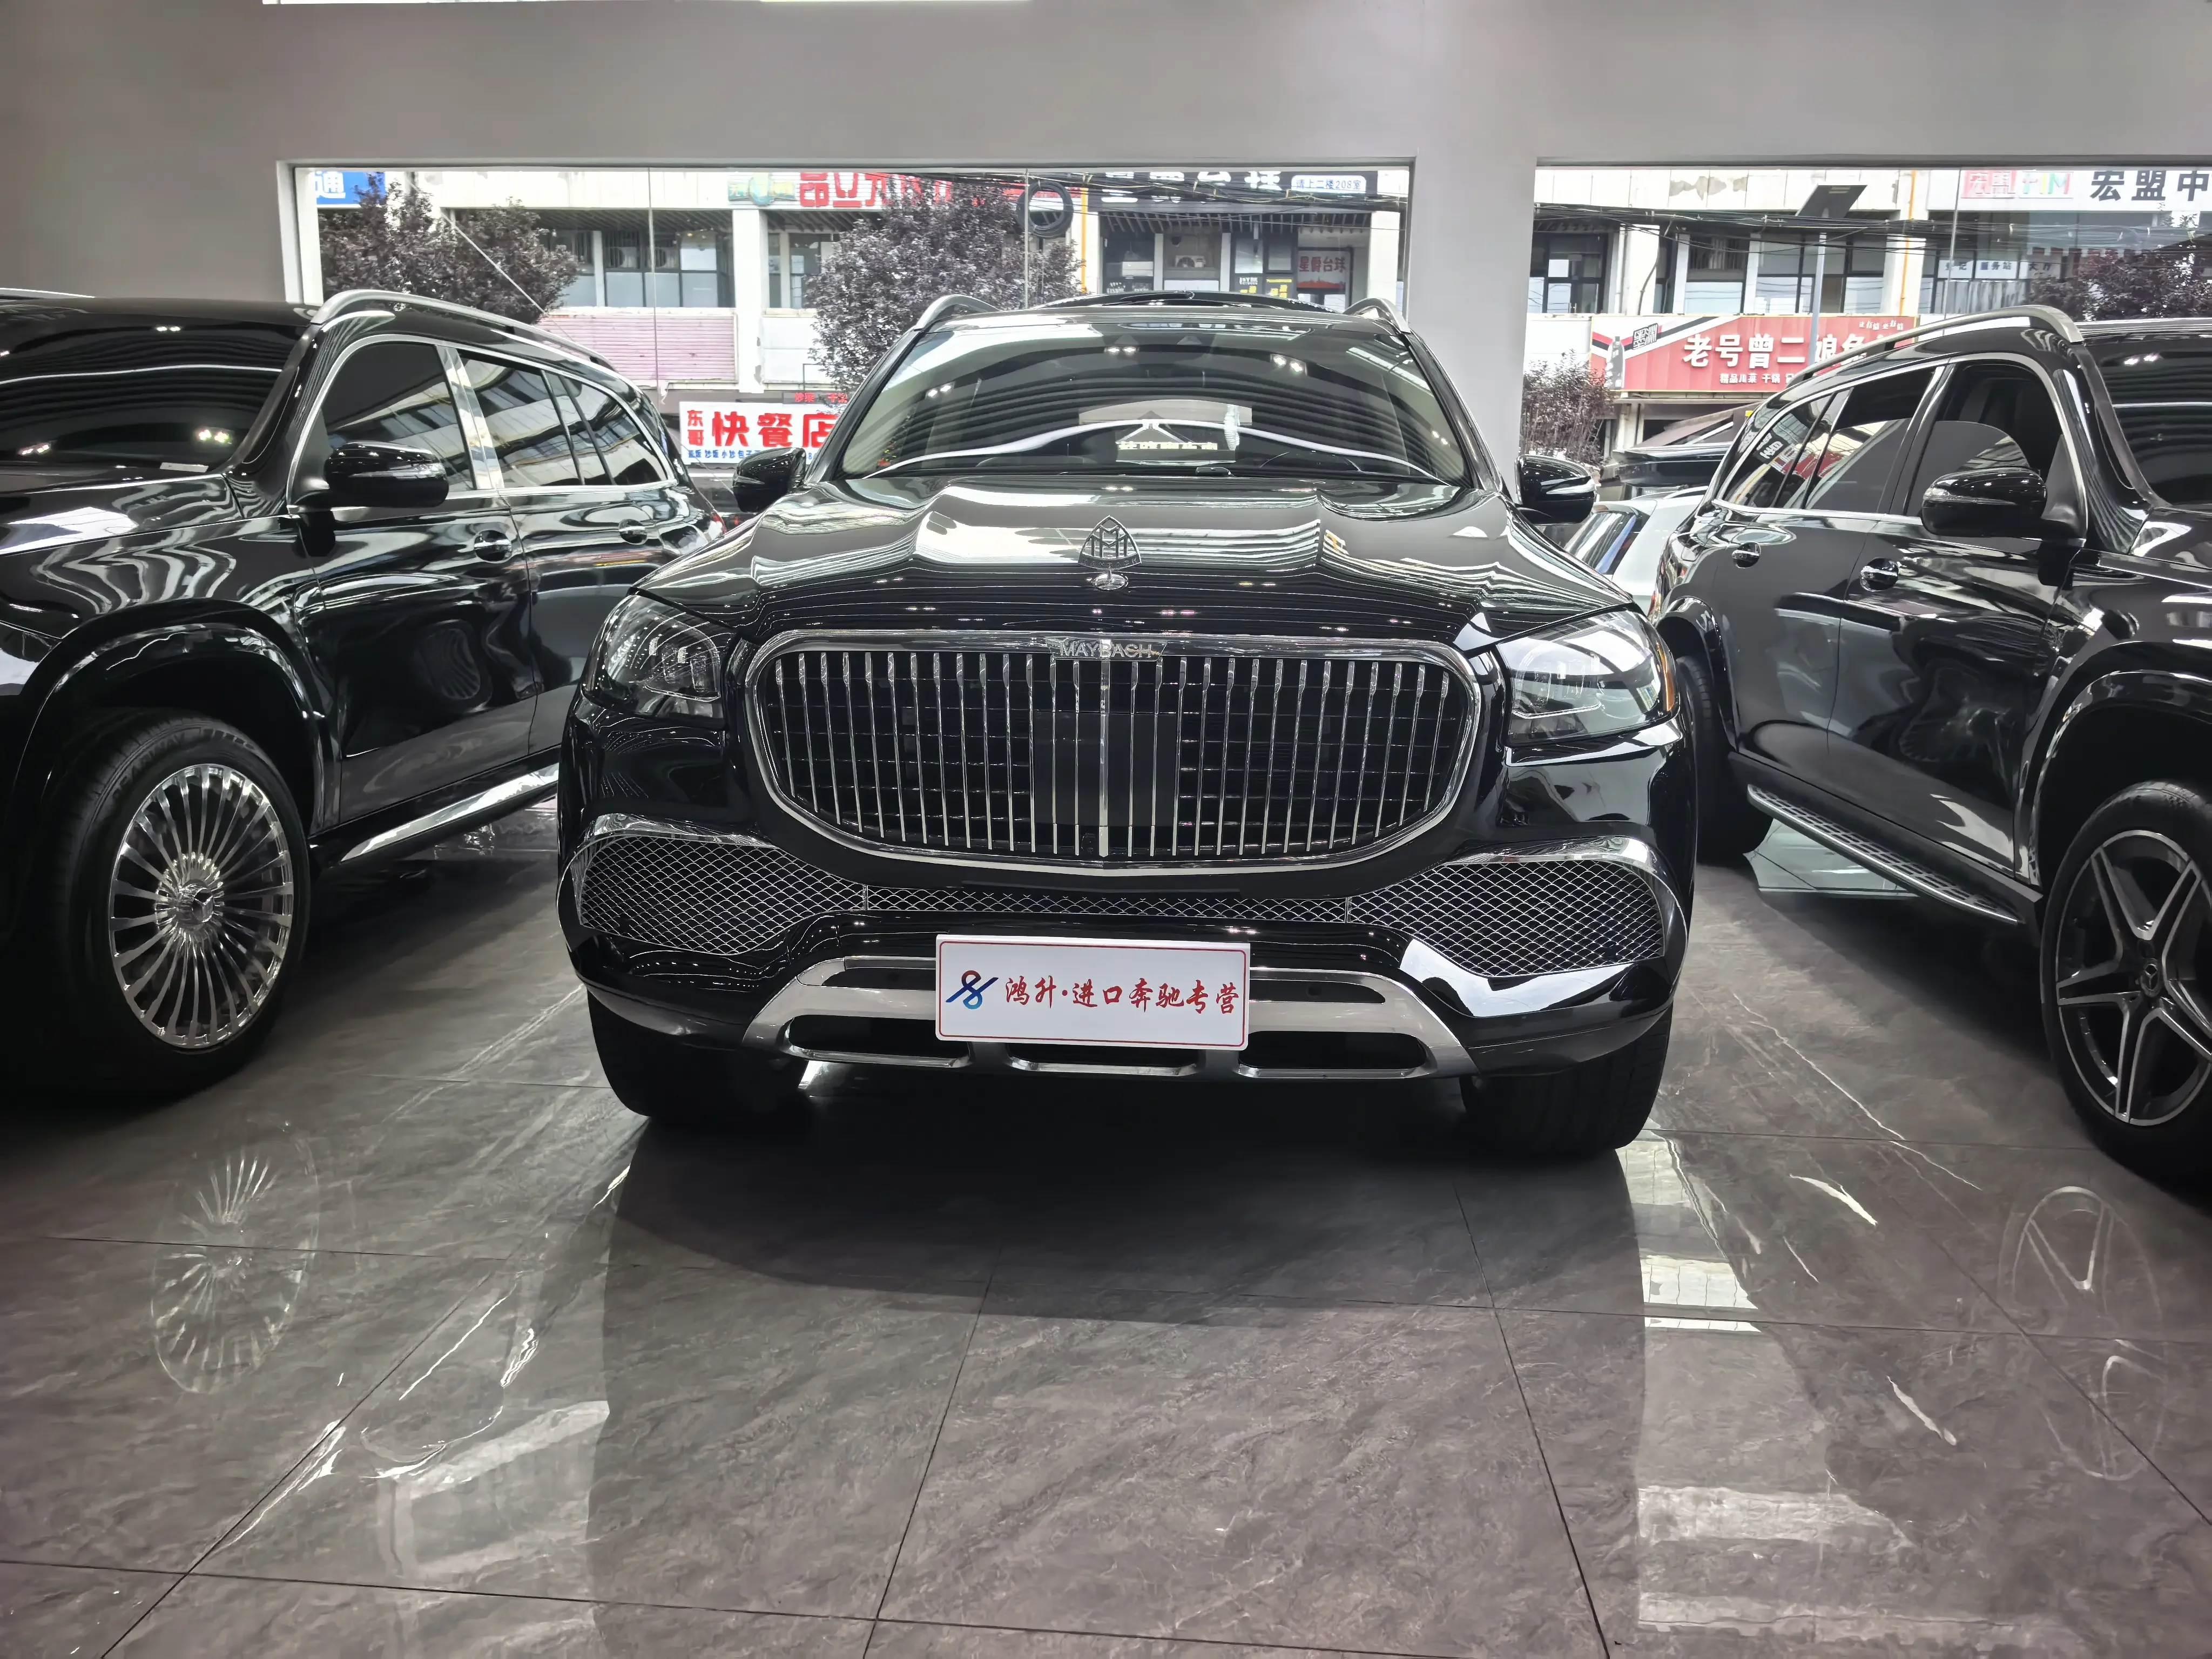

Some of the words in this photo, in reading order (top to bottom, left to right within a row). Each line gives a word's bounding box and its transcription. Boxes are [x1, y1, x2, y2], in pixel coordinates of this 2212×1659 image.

[712, 411, 839, 448] 快餐店
[1060, 643, 1152, 658] MAYBACH
[1005, 975, 1239, 1014] 鸿升·进口奔驰专营
